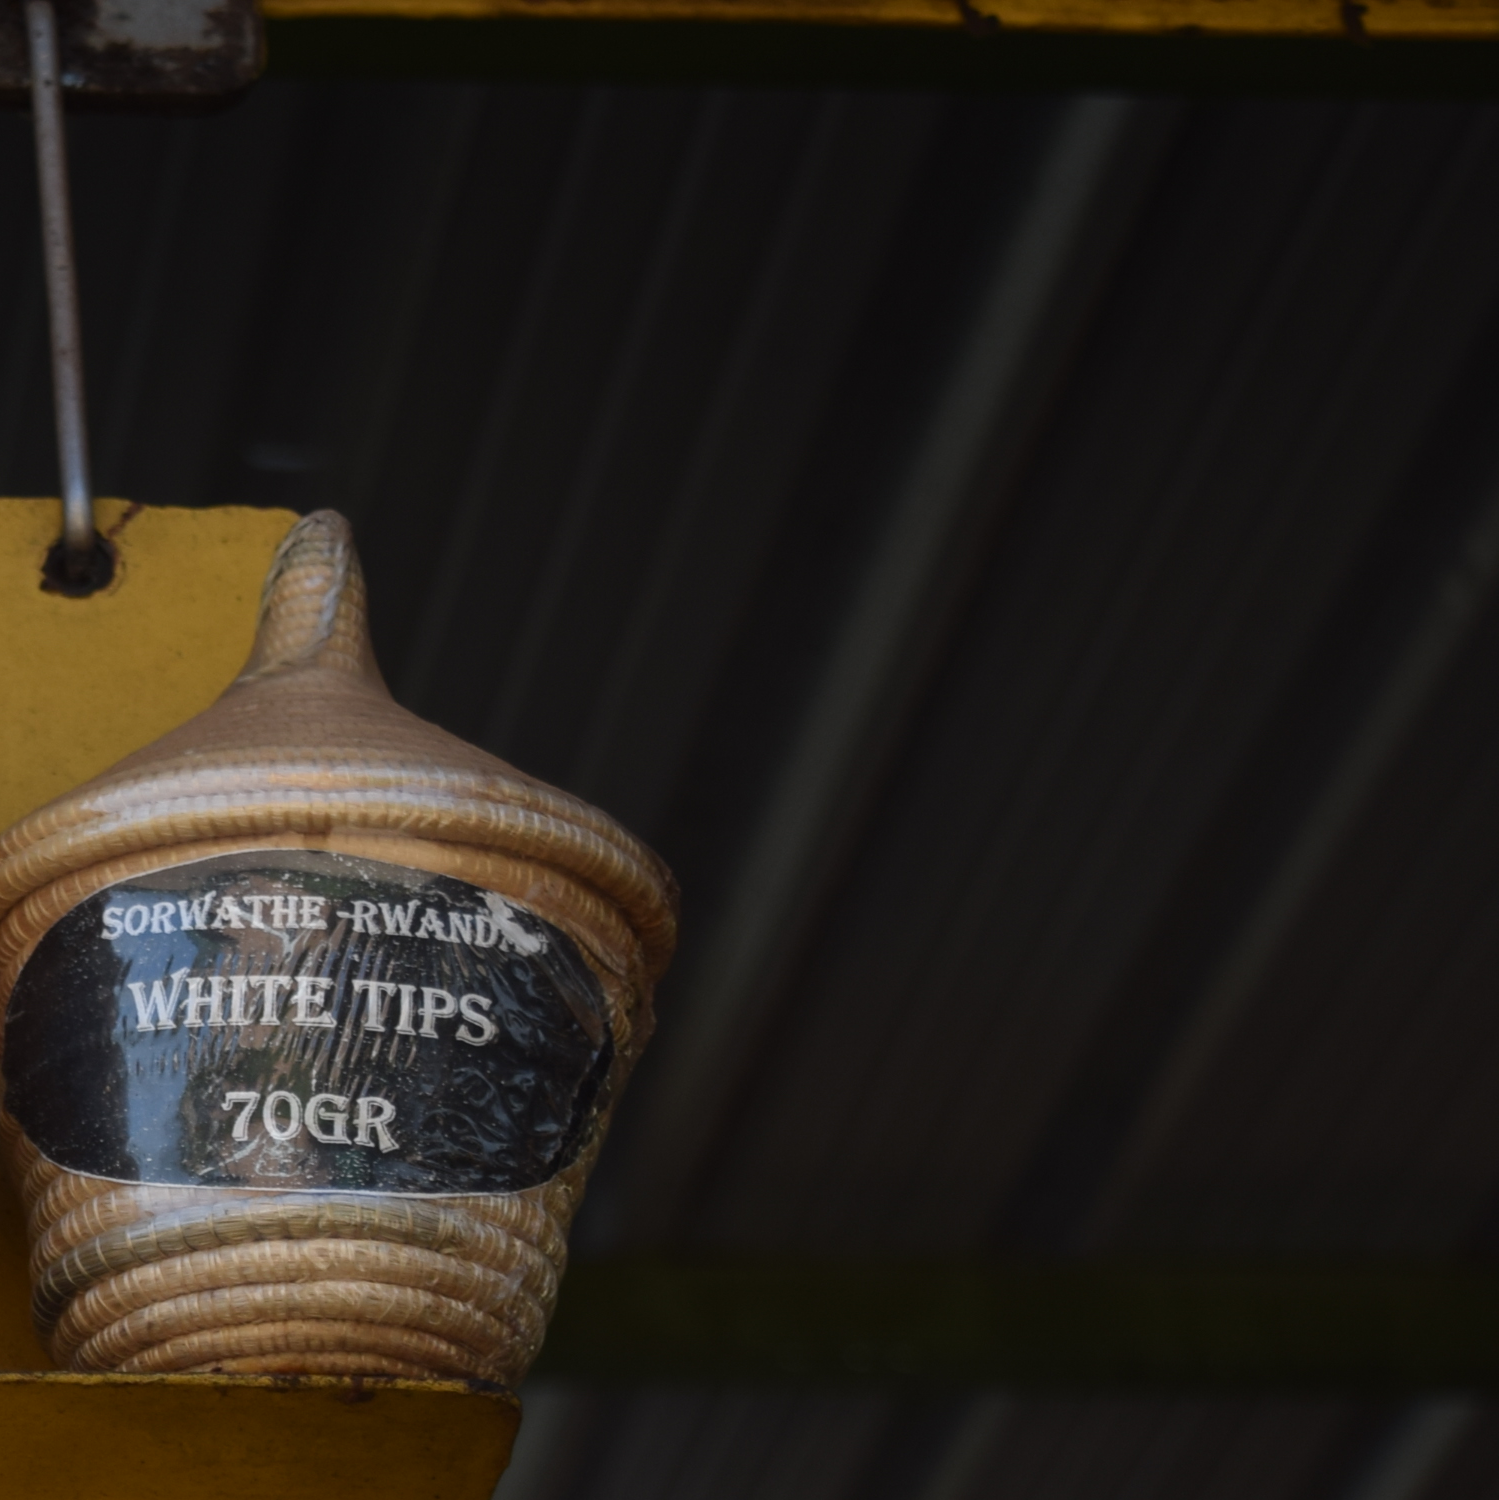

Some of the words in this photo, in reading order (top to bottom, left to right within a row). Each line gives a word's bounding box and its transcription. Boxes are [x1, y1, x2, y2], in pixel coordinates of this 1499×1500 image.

[101, 890, 327, 941] SORWATHE
[128, 968, 336, 1033] WHITE
[353, 980, 497, 1047] TIPS
[220, 1090, 400, 1153] 70GR
